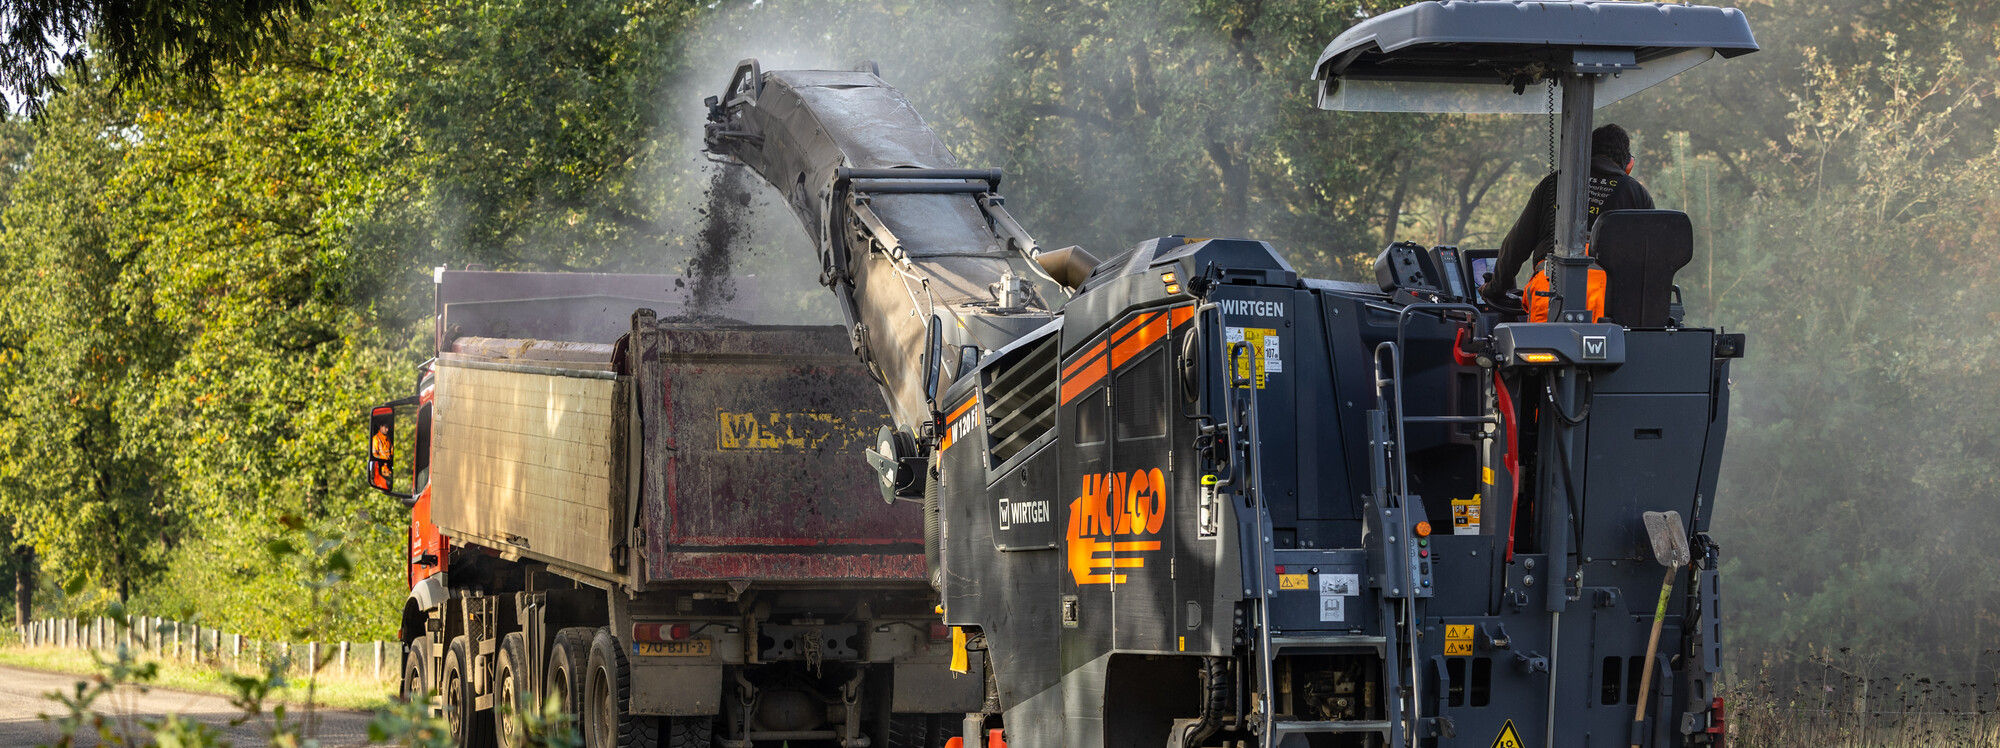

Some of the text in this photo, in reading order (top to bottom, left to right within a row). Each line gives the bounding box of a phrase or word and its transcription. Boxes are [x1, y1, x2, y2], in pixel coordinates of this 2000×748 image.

[1221, 299, 1284, 317] WIRTGEN
[951, 405, 978, 445] W 120 Fi
[1011, 500, 1050, 524] WIRTGEN
[1080, 467, 1167, 537] HOLGO
